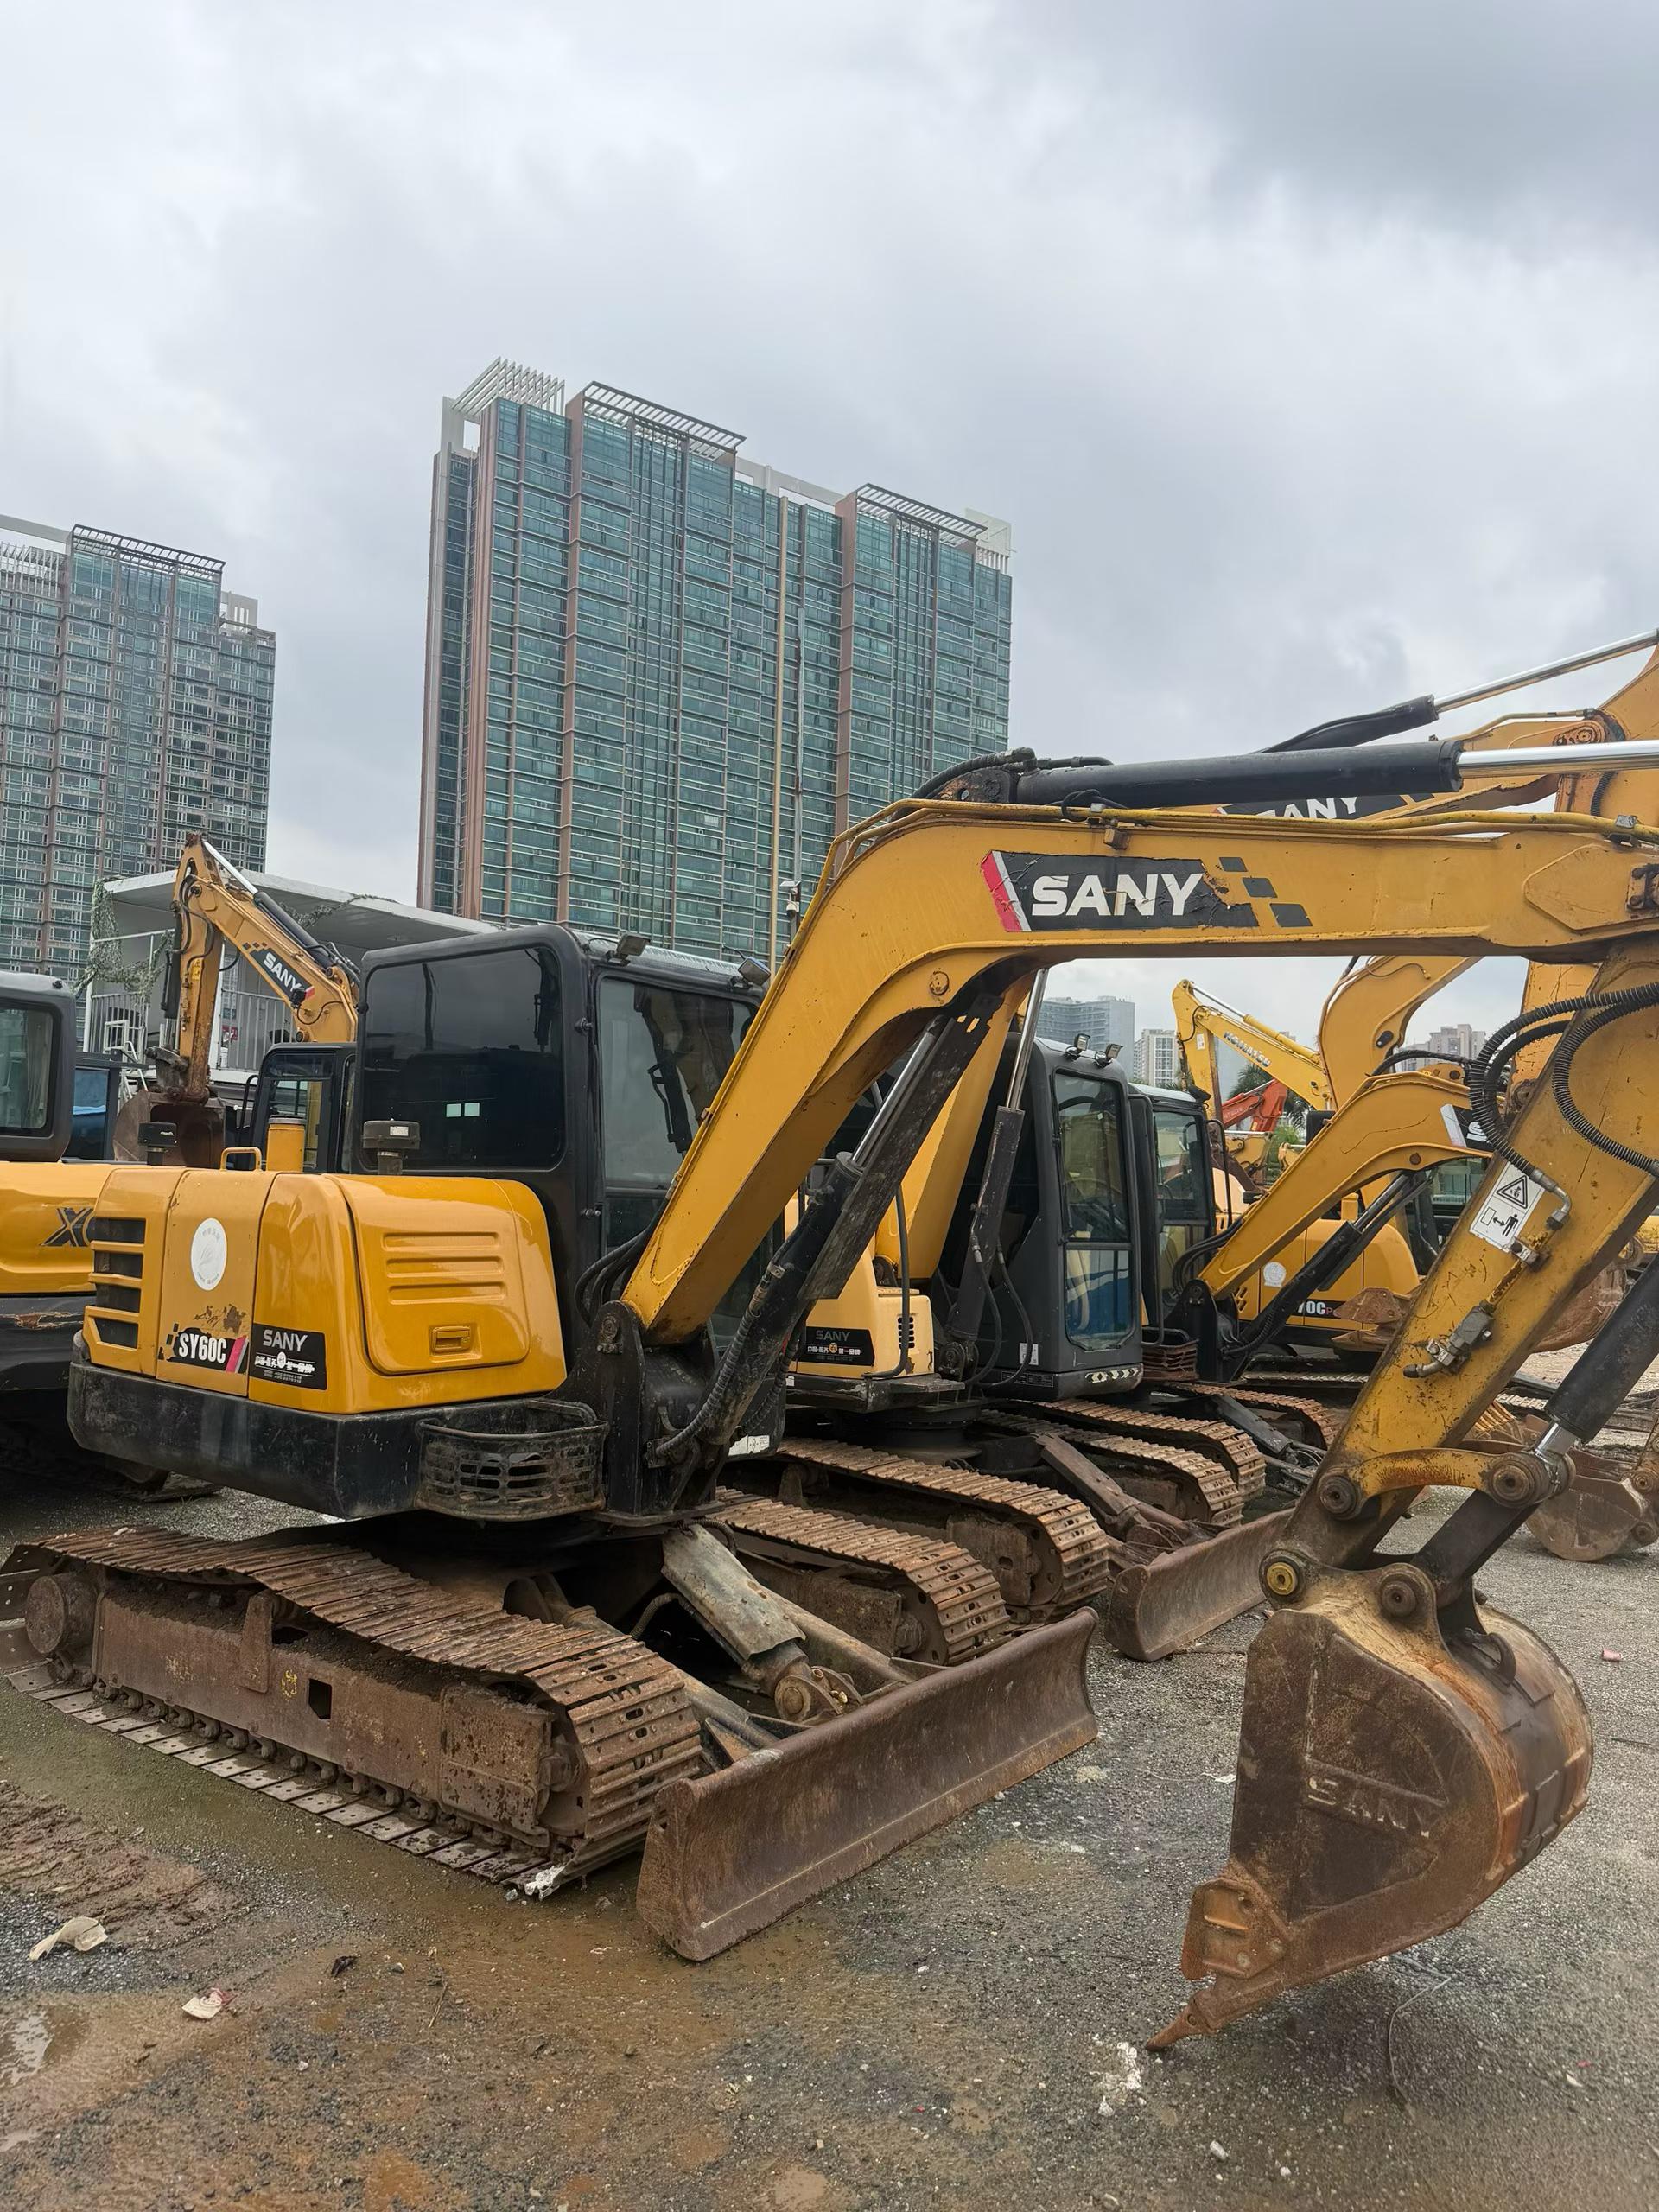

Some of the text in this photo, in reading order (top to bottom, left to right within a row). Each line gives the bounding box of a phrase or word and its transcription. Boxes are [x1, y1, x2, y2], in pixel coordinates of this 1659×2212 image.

[1032, 873, 1204, 916] SANY
[263, 951, 302, 993] SANY
[1224, 1031, 1271, 1068] KOMATSU
[178, 1332, 227, 1364] SY60C
[263, 1328, 308, 1352] SANY
[815, 1330, 850, 1342] SANY
[1308, 1775, 1441, 1838] SANY
